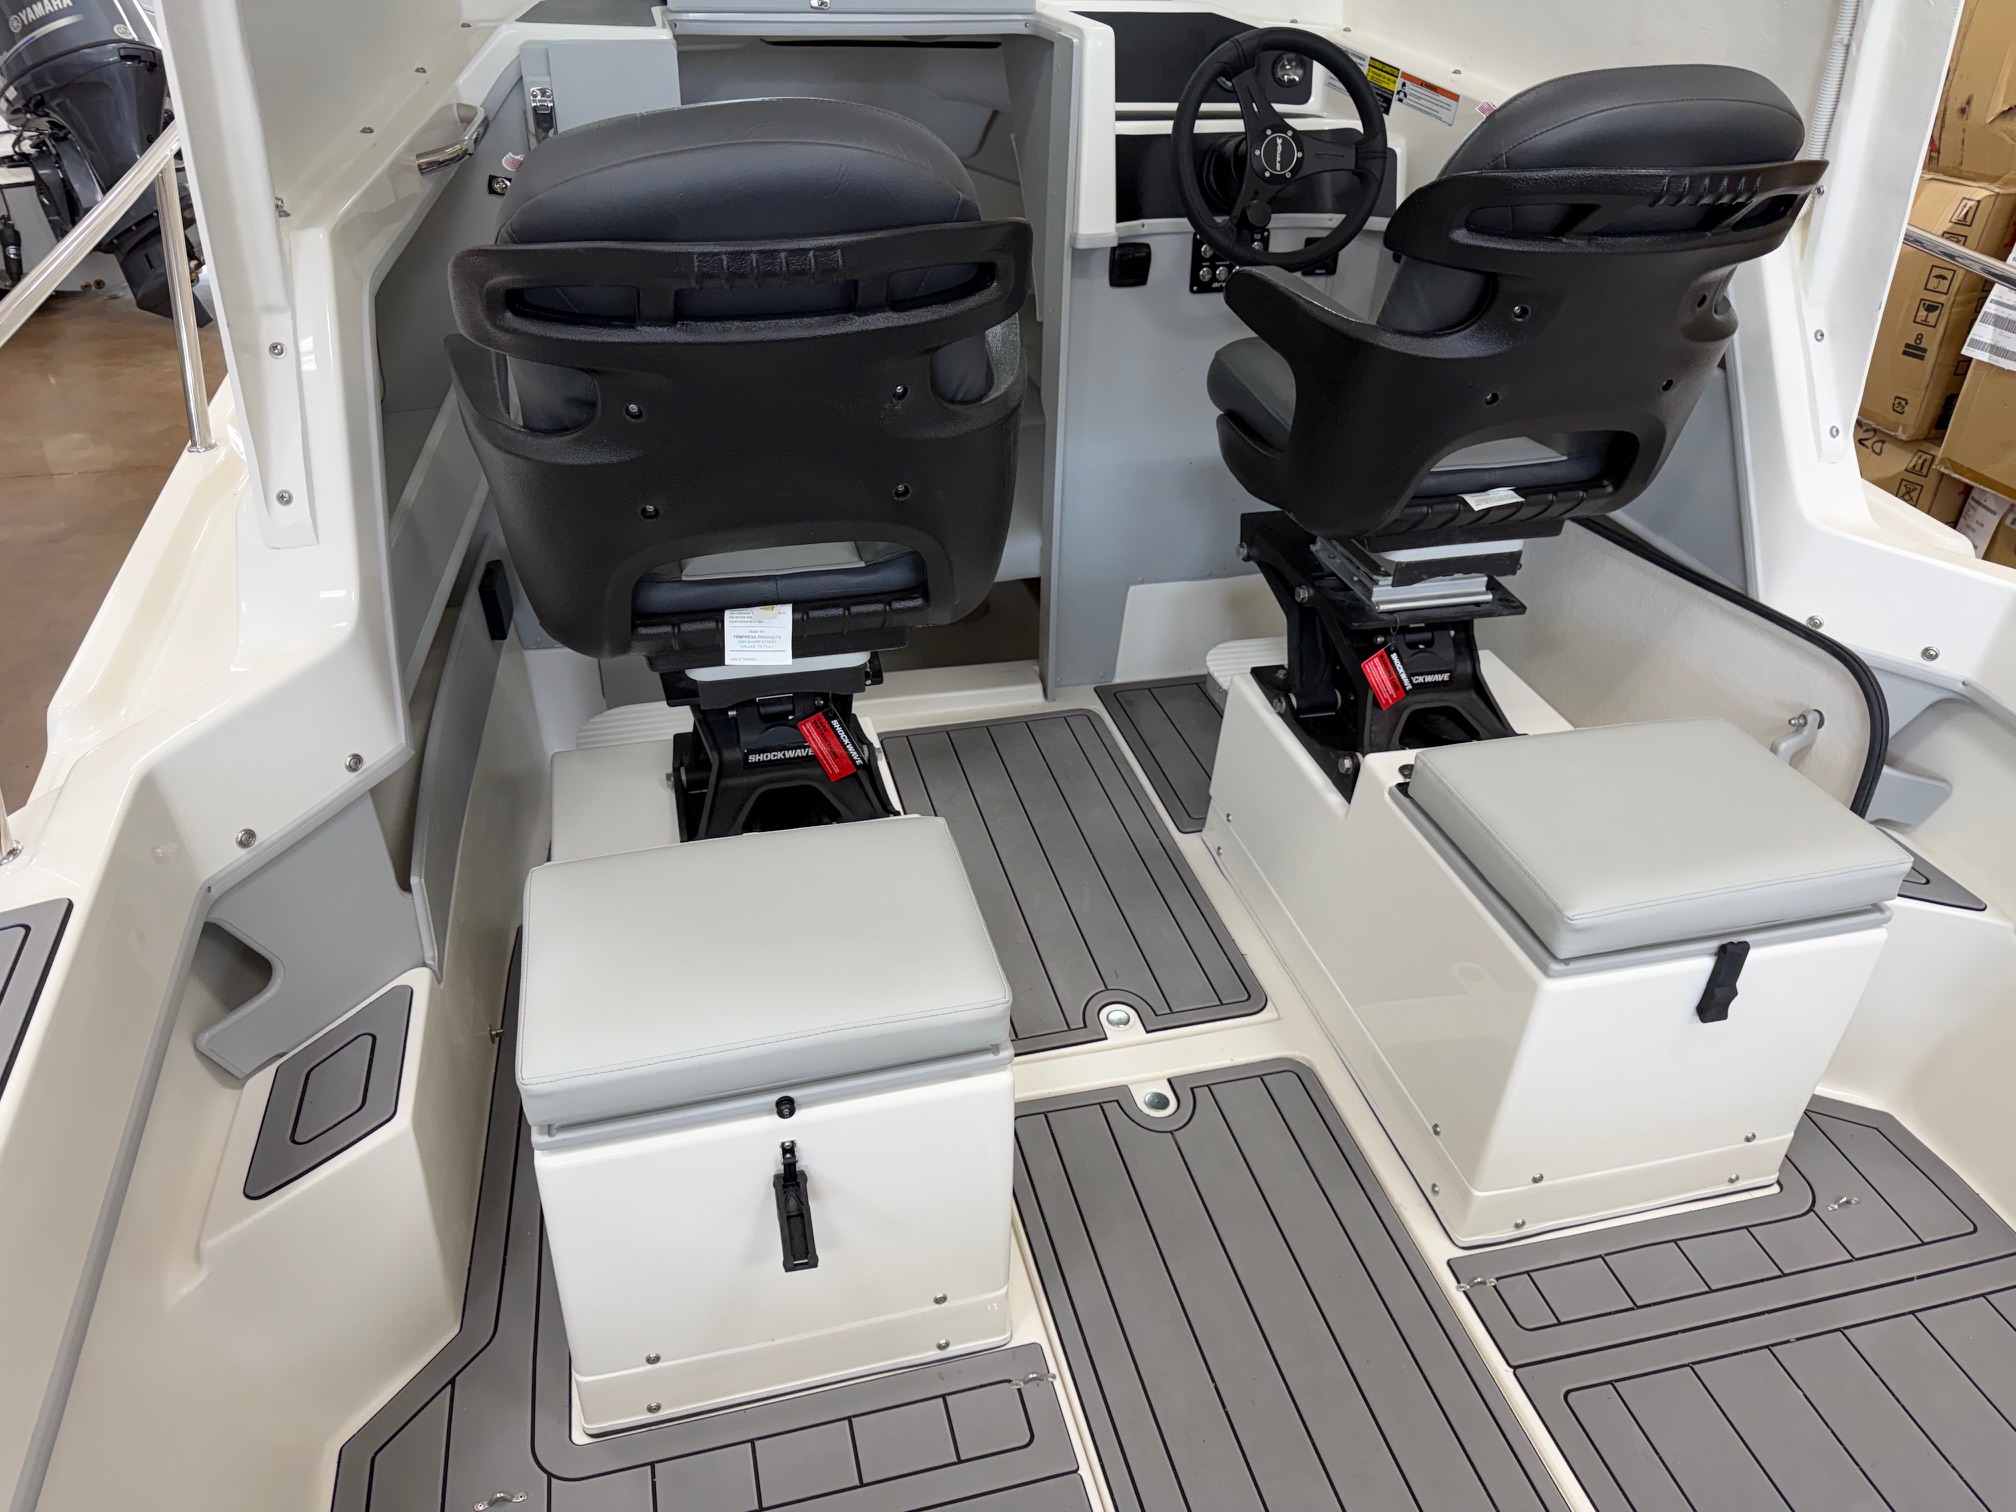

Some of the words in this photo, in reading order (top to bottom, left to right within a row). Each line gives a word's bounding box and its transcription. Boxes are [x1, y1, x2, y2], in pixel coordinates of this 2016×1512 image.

[18, 0, 74, 26] YAMAHA
[1913, 333, 1924, 346] 8
[1390, 652, 1413, 691] SHOCKWAVE
[1411, 673, 1450, 684] CKWAVE
[831, 719, 863, 766] SHOCKWAVE
[748, 747, 815, 763] SHOCKWAVE
